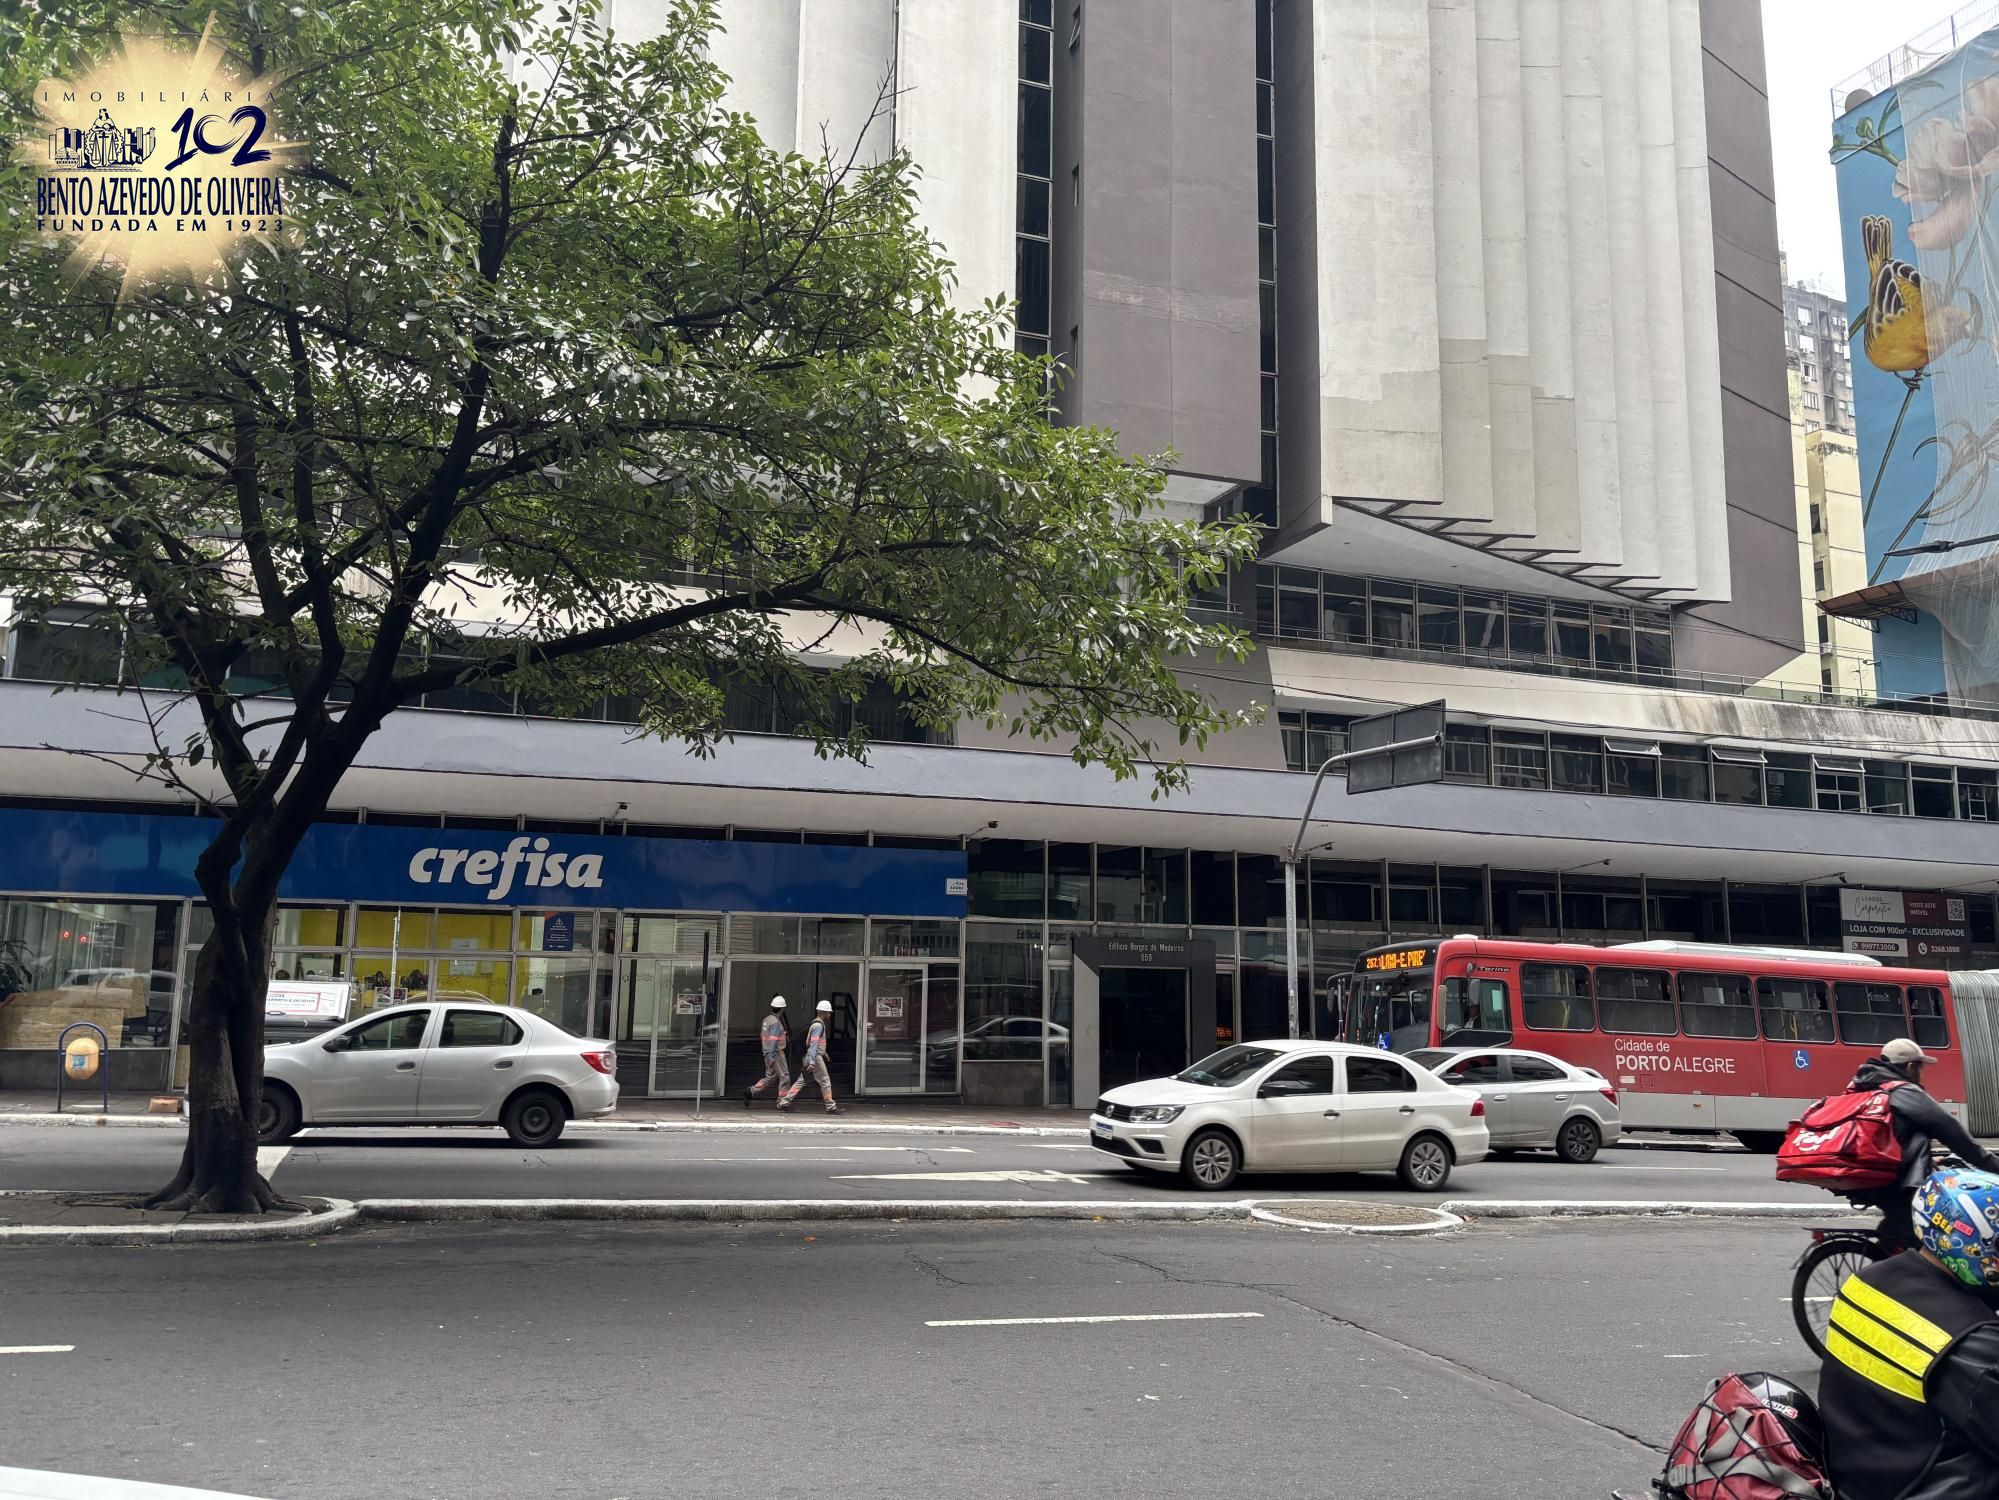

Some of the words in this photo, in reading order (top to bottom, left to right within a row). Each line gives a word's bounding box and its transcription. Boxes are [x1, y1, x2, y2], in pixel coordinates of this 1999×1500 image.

[409, 836, 604, 901] crefisa
[1849, 924, 1868, 933] LOJA
[1869, 925, 1886, 934] COM
[1912, 928, 1965, 937] EXCLUSIVIDADE
[1614, 1038, 1654, 1052] Cidade
[1656, 1040, 1670, 1053] de
[1615, 1054, 1671, 1072] PORTO
[1673, 1056, 1736, 1074] ALEGRE
[1931, 1211, 1954, 1235] BEE
